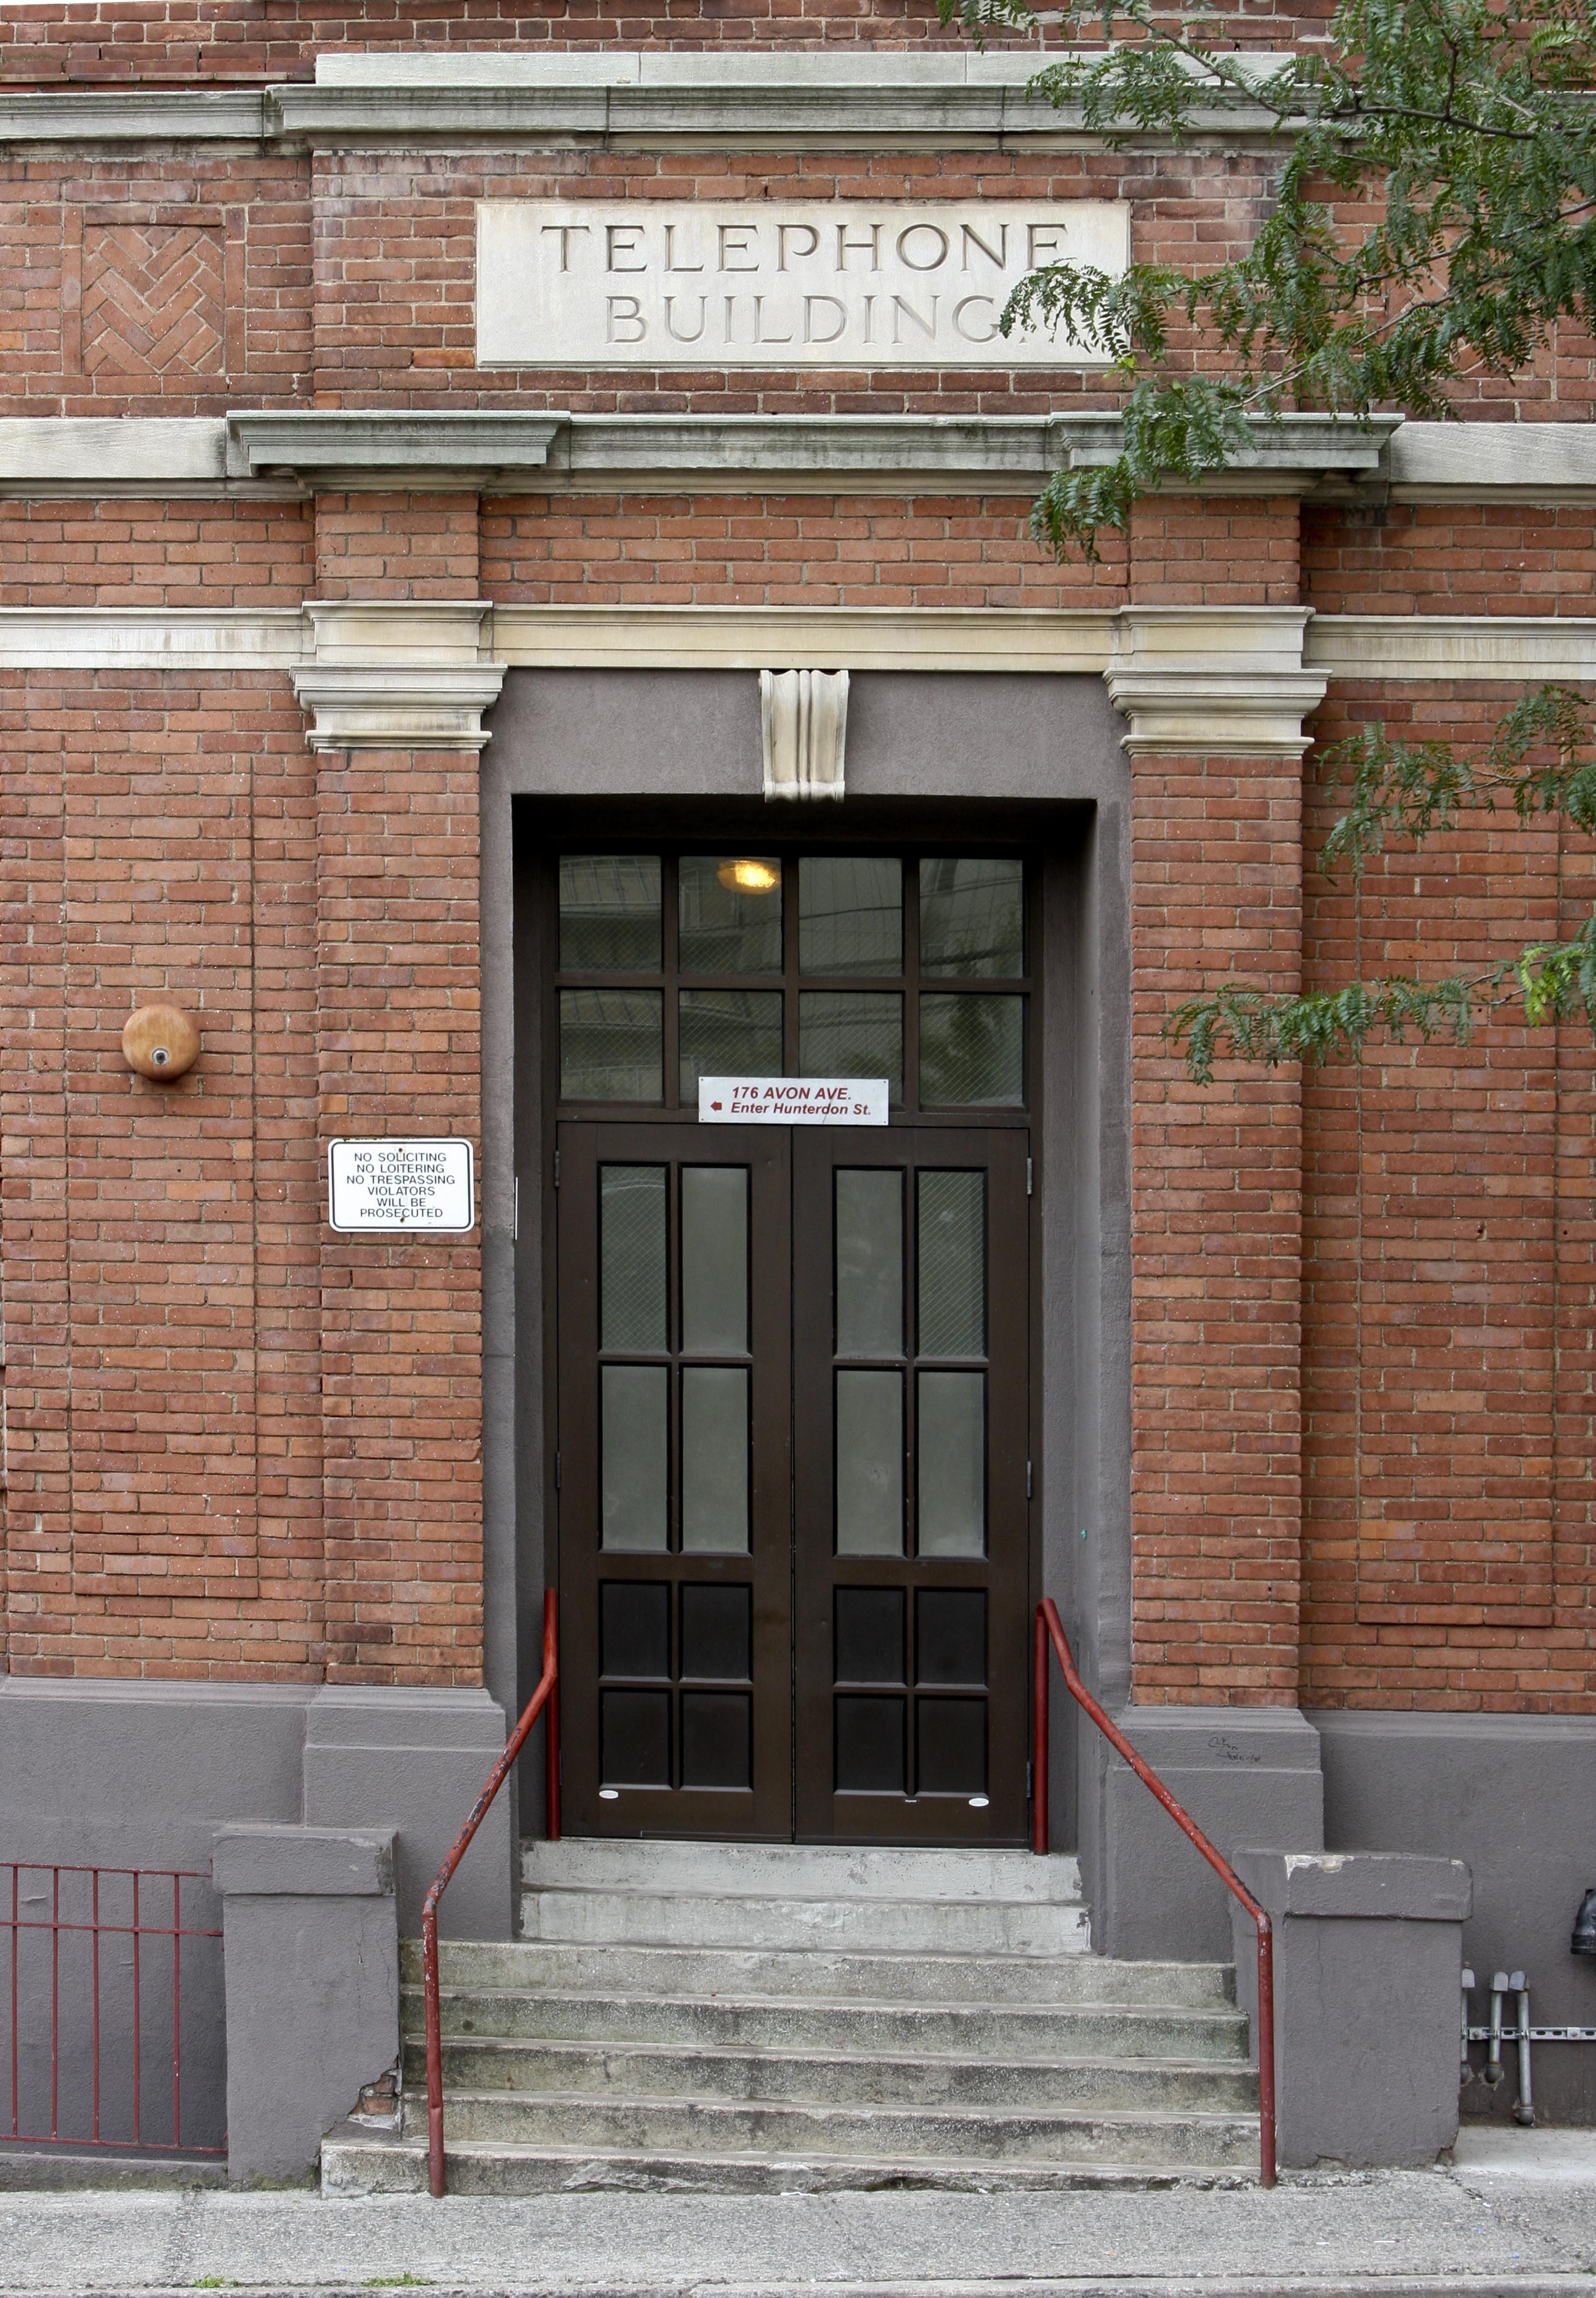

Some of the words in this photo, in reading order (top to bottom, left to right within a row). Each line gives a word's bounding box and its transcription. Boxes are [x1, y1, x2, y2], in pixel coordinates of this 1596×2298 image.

[540, 223, 1068, 273] TELEPHONE
[732, 1087, 759, 1099] 176
[763, 1087, 810, 1100] AVON
[815, 1087, 852, 1100] AVE.
[731, 1102, 770, 1114] Enter
[773, 1102, 848, 1115] Hunterdon
[853, 1104, 871, 1116] St.
[354, 1153, 372, 1162] NO
[378, 1153, 447, 1162] SOLICITING
[357, 1164, 374, 1174] NO
[381, 1164, 445, 1174] LOITERING
[346, 1175, 365, 1185] NO
[370, 1175, 456, 1185] TRESPASSING
[368, 1186, 435, 1196] VIOLATORS
[377, 1198, 406, 1207] WILL
[411, 1198, 427, 1207] BE
[360, 1208, 443, 1218] PROSECUTED
